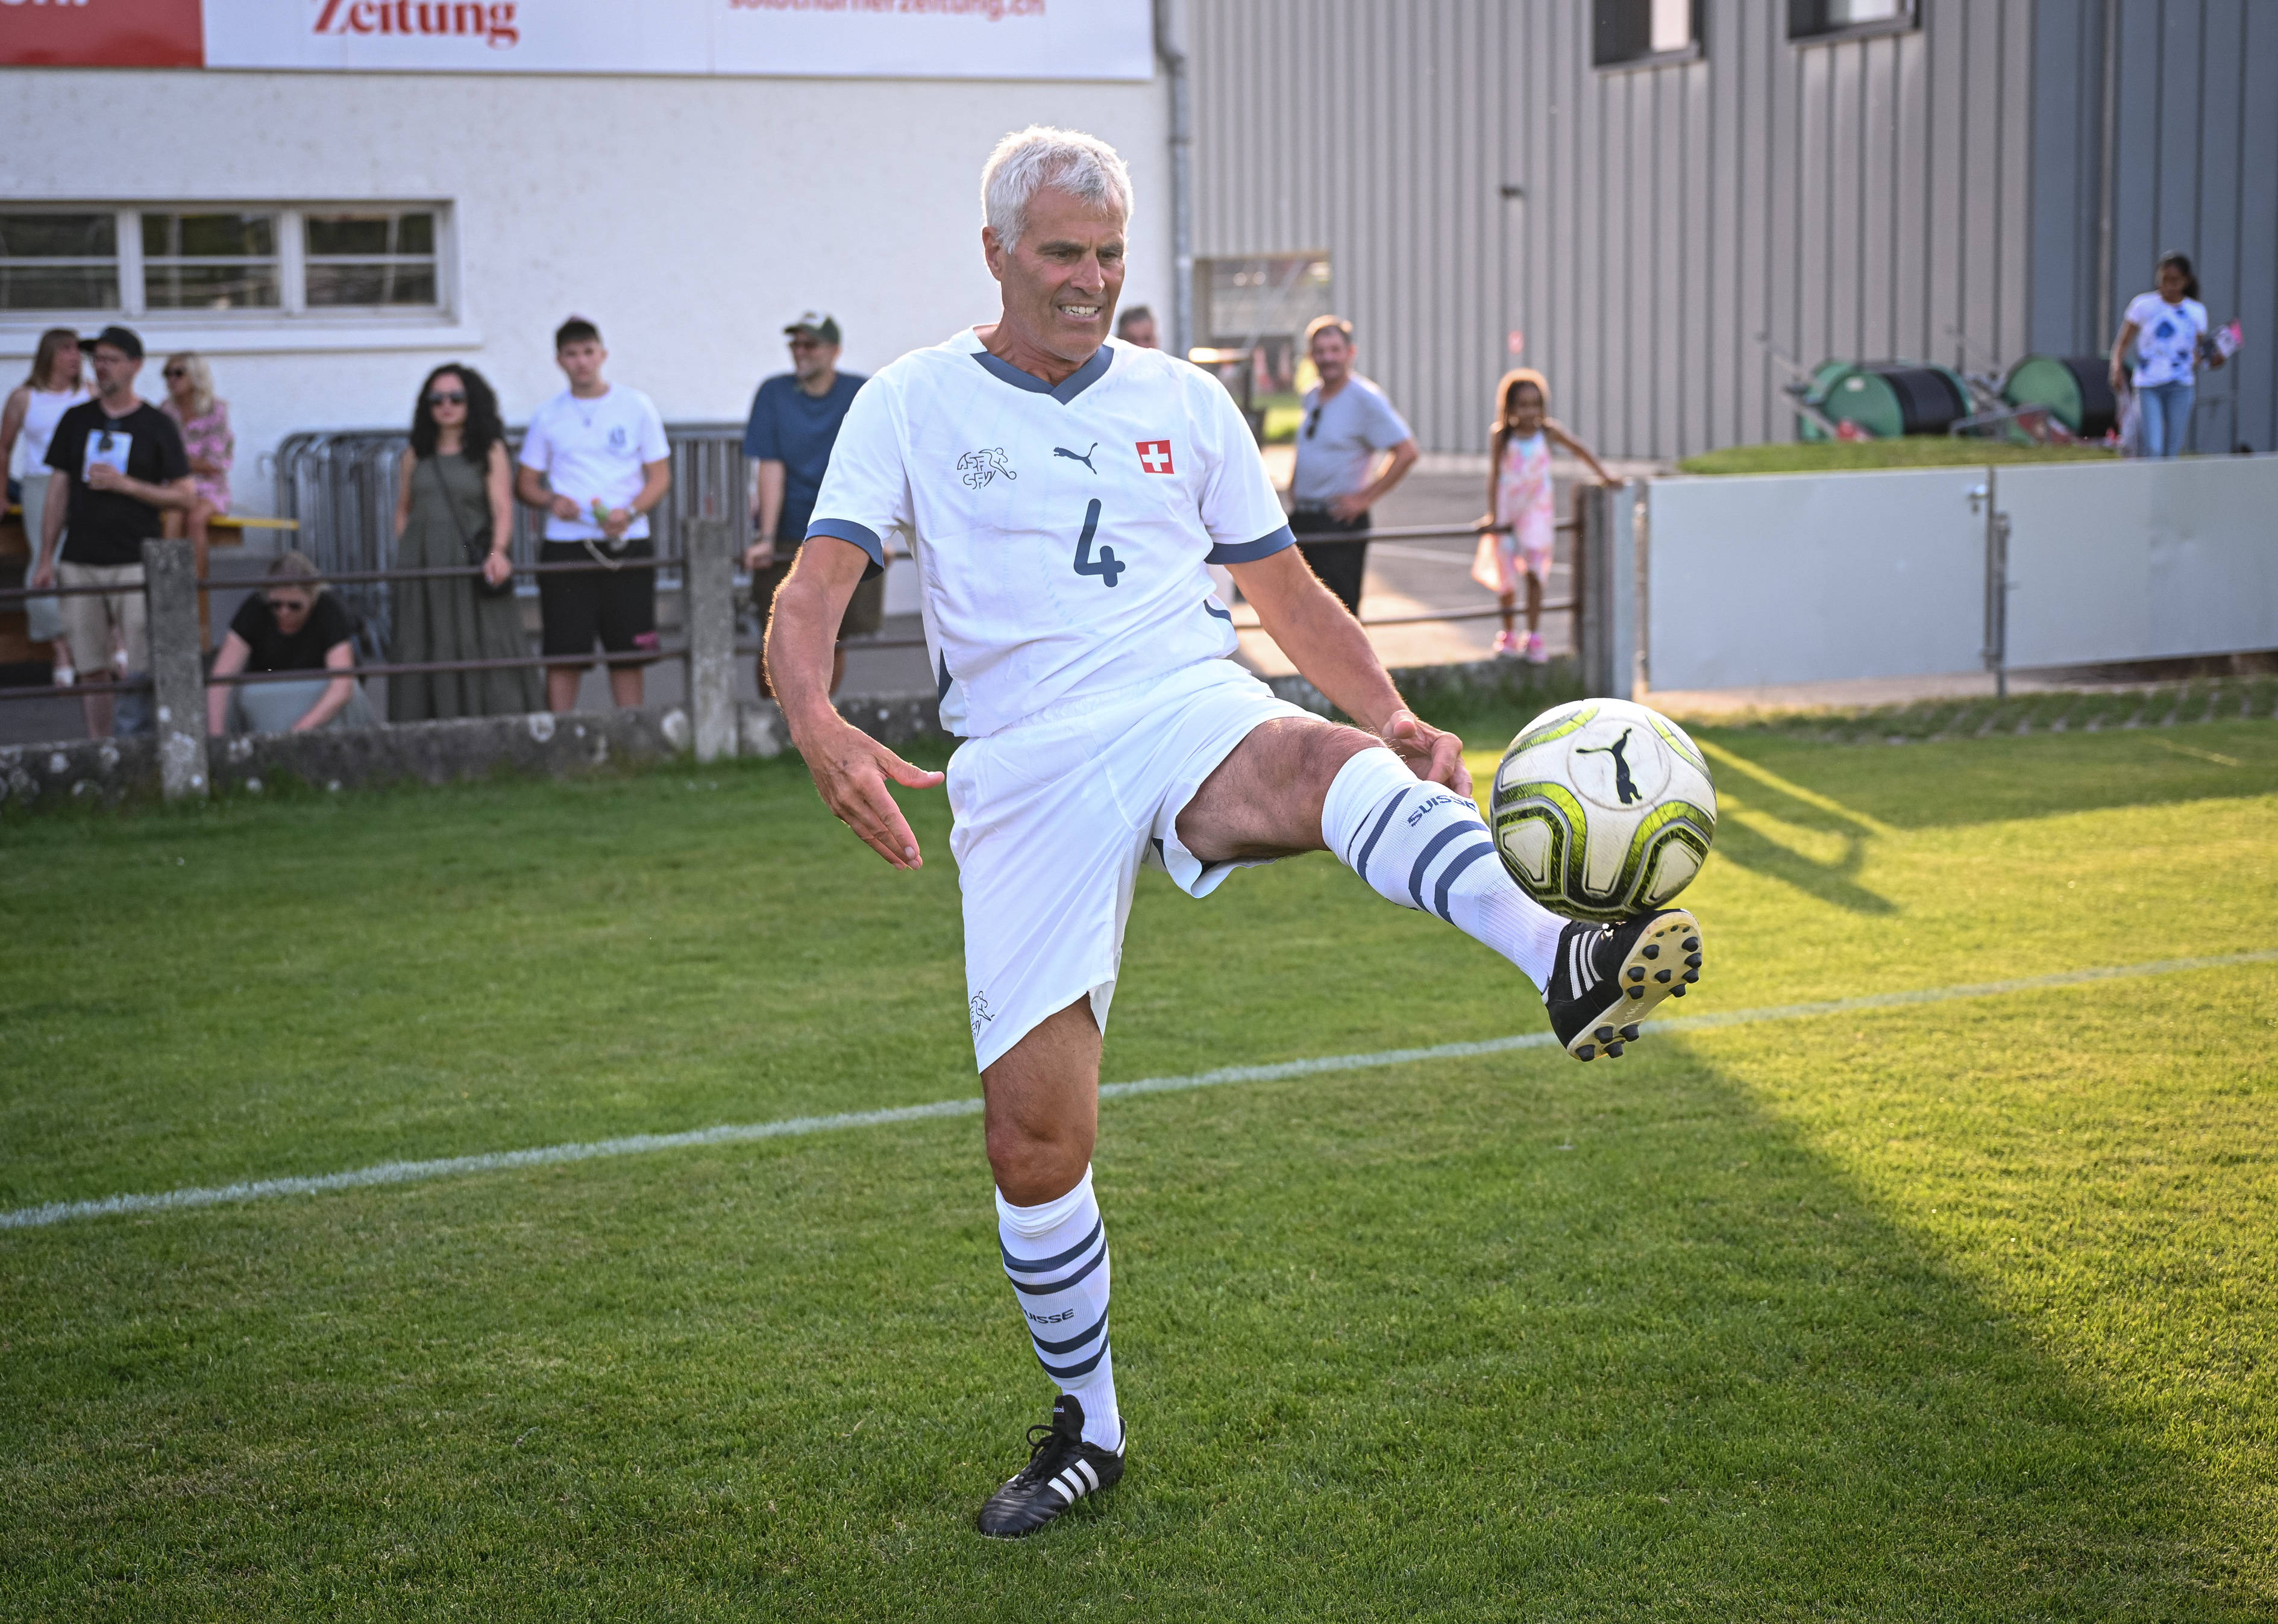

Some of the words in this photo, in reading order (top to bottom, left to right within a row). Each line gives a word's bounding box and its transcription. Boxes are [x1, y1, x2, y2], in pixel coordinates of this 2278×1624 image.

[312, 0, 521, 50] Zeitung
[1073, 498, 1126, 588] 4
[1023, 1308, 1075, 1324] UISSE
